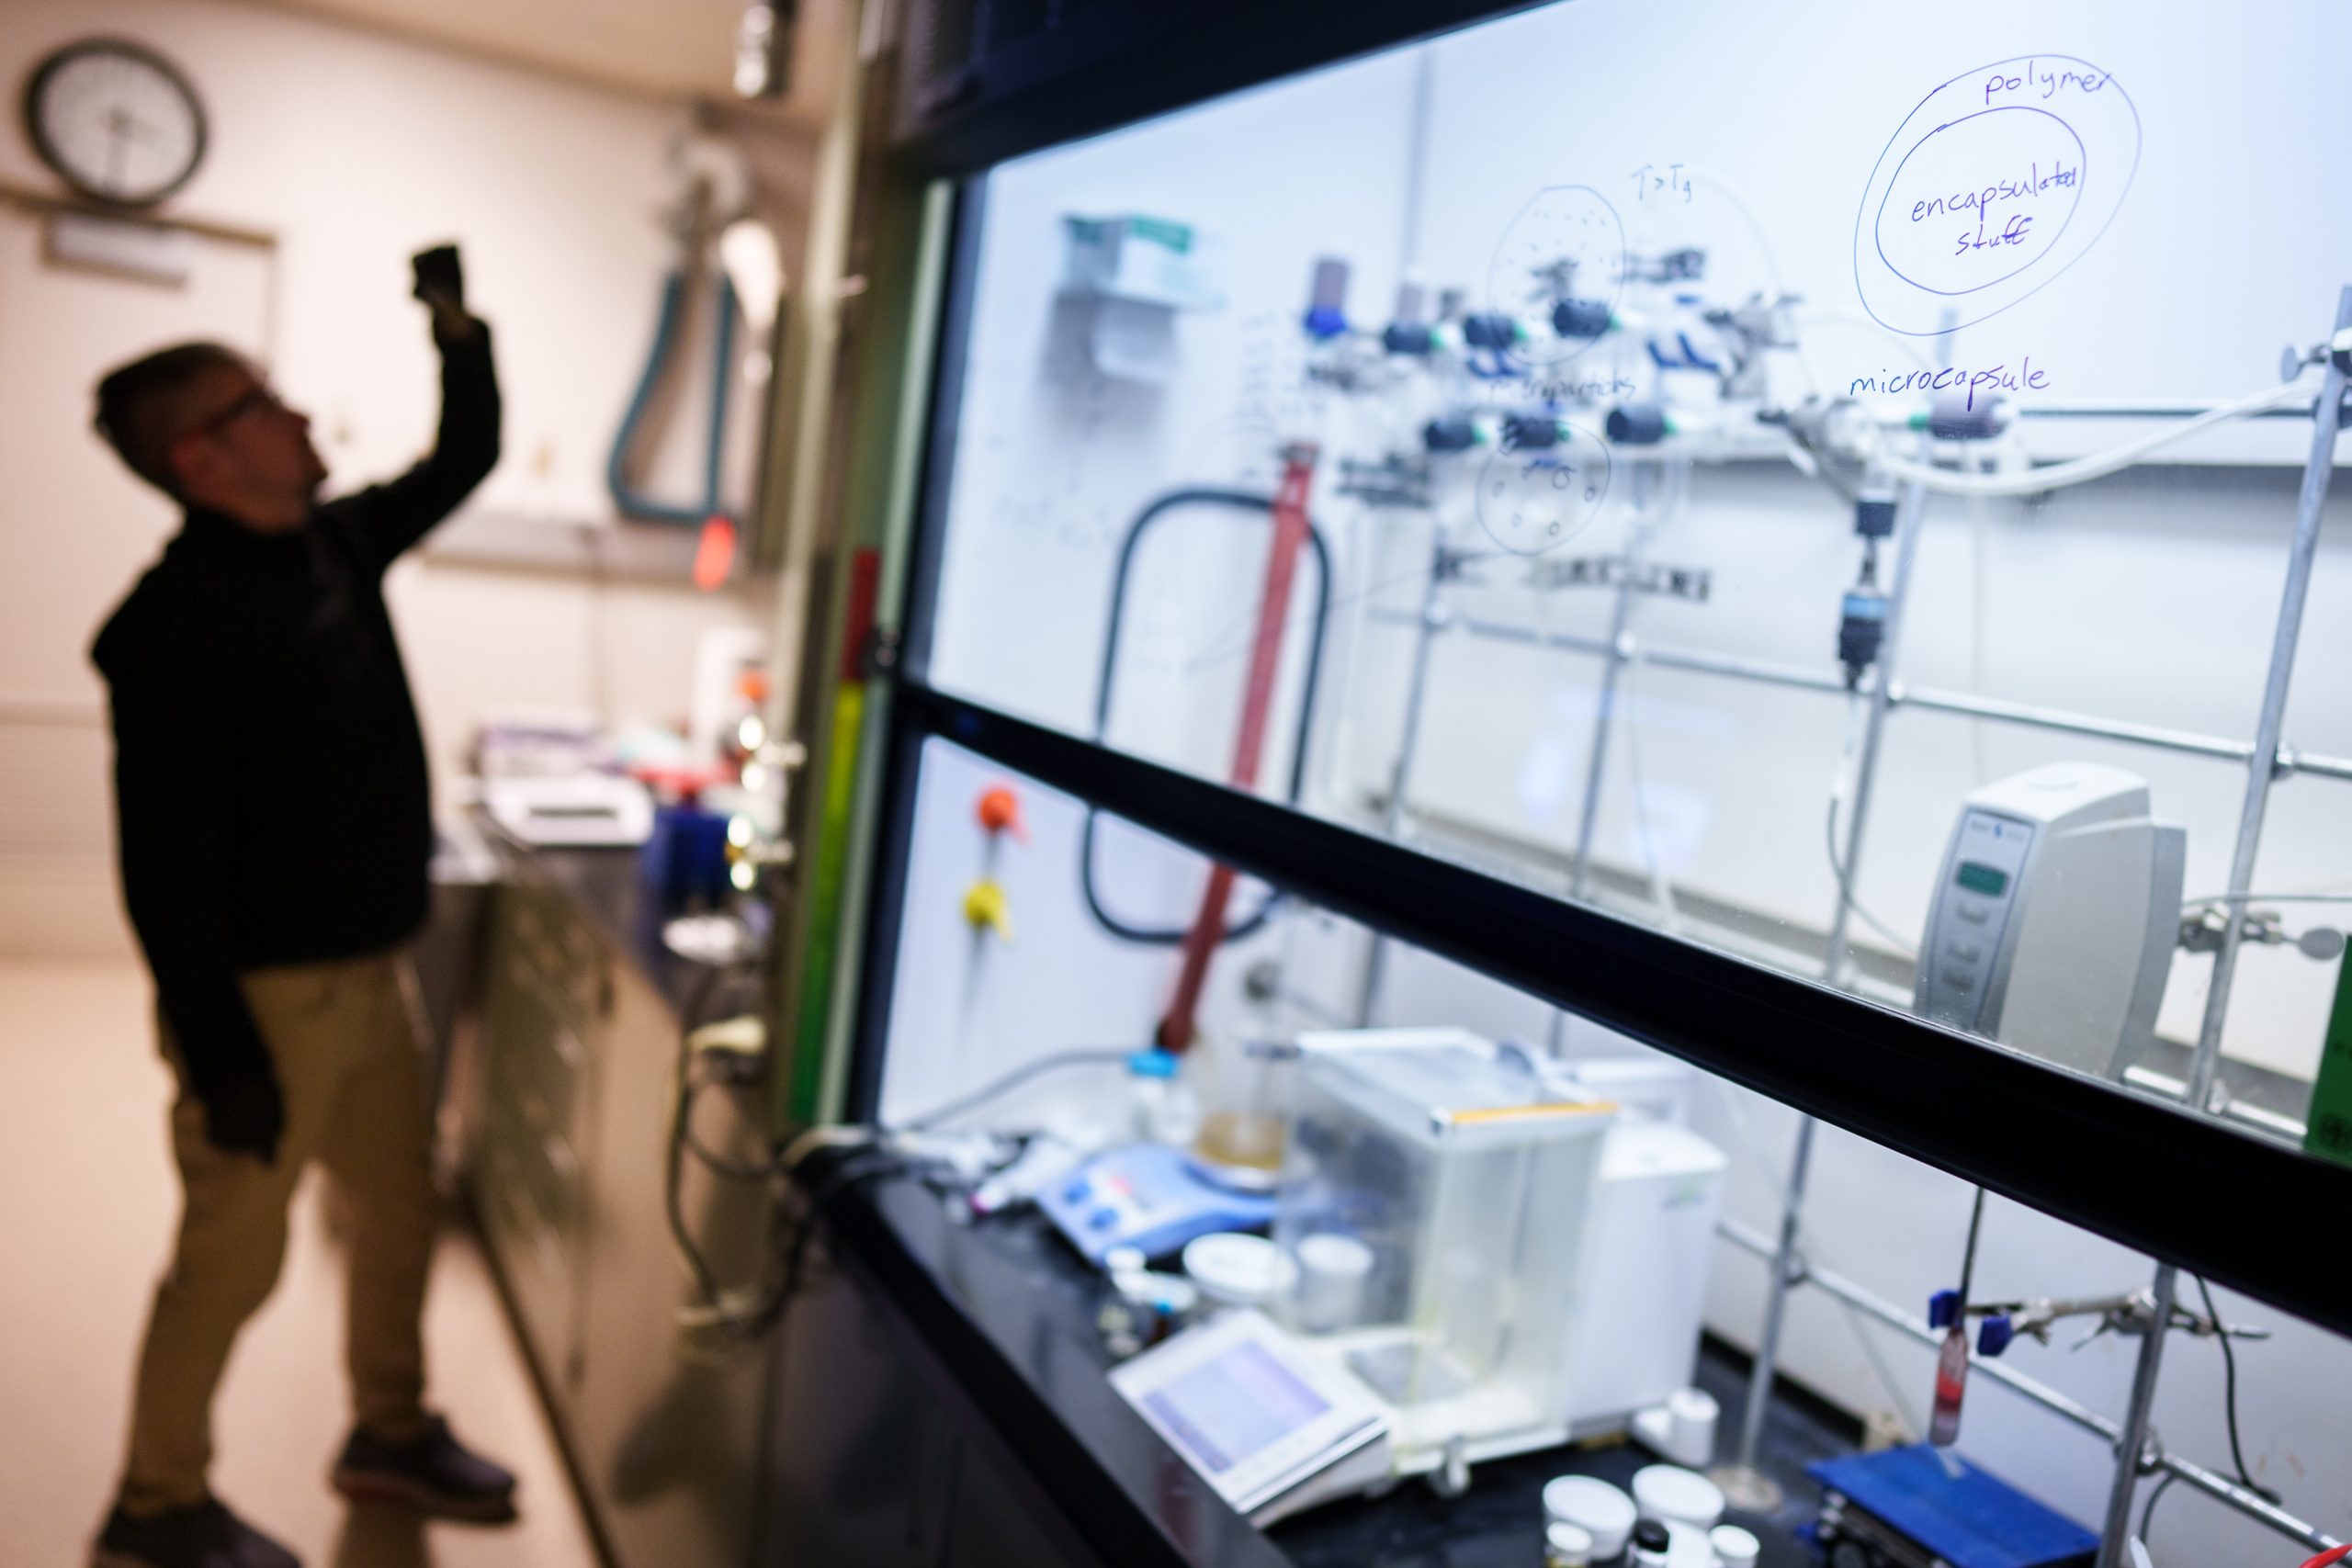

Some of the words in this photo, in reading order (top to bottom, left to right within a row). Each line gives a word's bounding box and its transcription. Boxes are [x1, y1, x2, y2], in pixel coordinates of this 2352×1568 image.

[1985, 59, 2111, 107] polymer
[1911, 161, 2077, 222] encapsulated
[1955, 214, 2034, 256] stuff
[1849, 355, 2052, 413] microcapsule
